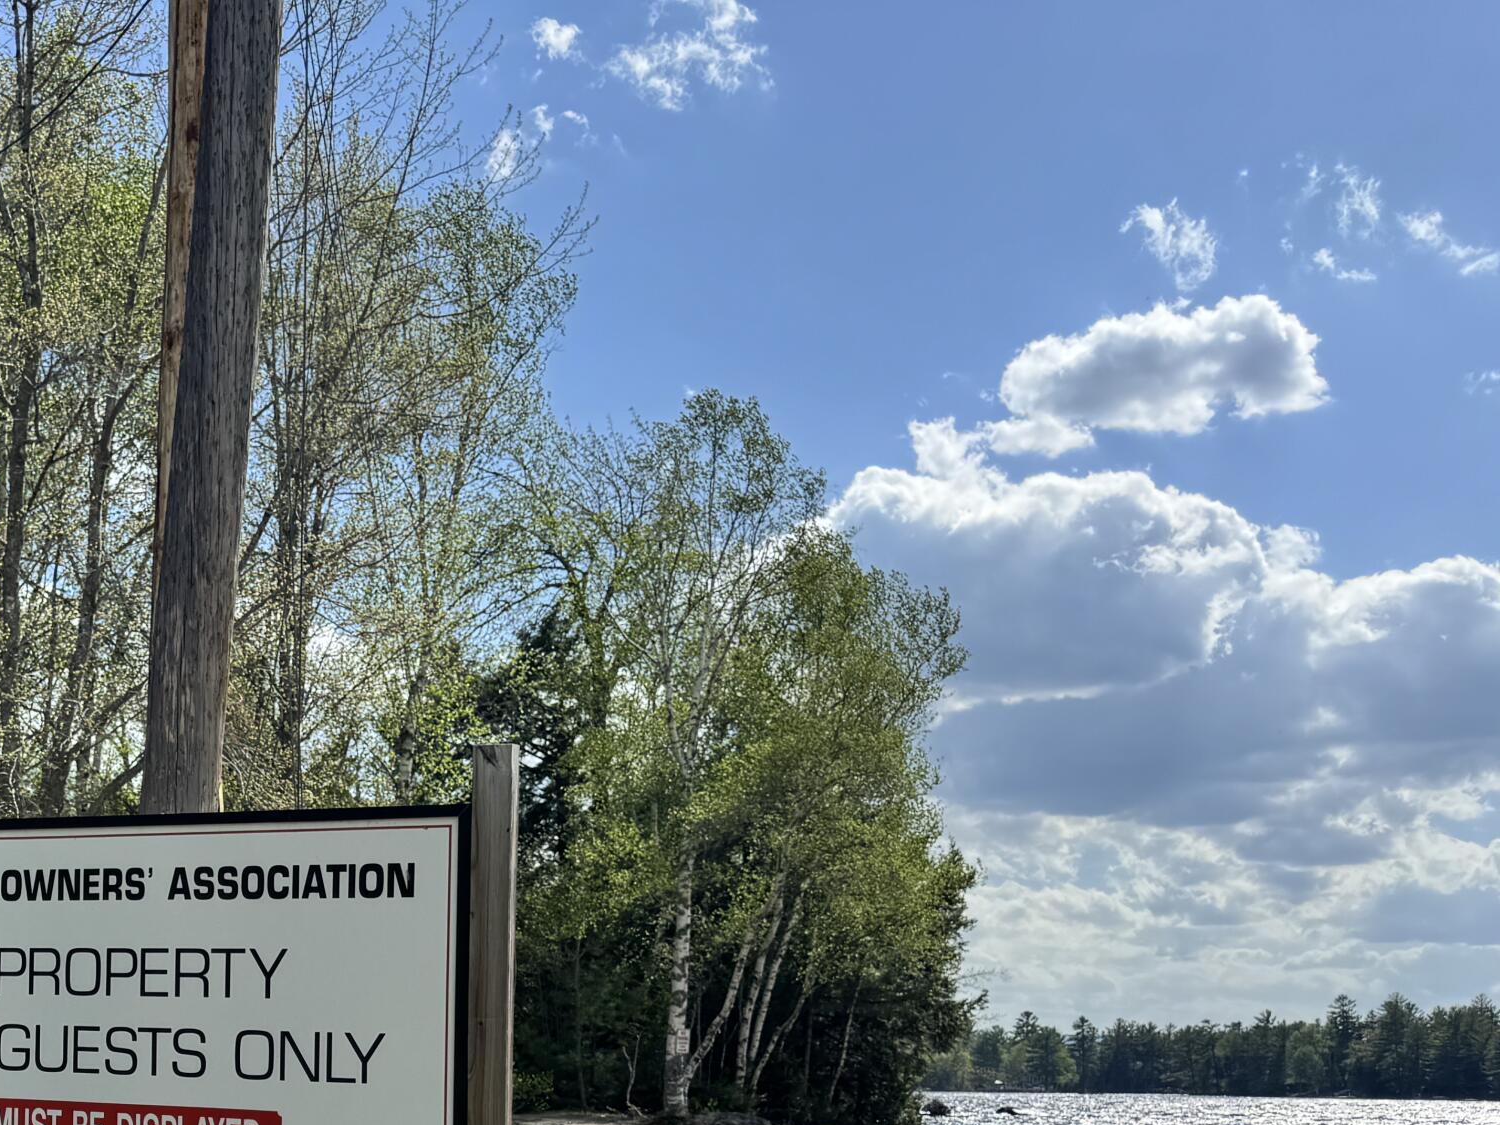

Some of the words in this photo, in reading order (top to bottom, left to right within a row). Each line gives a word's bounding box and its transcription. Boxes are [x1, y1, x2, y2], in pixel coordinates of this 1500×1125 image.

[0, 867, 153, 902] OWNERS'
[167, 862, 415, 900] ASSOCIATION
[235, 1029, 386, 1084] ONLY
